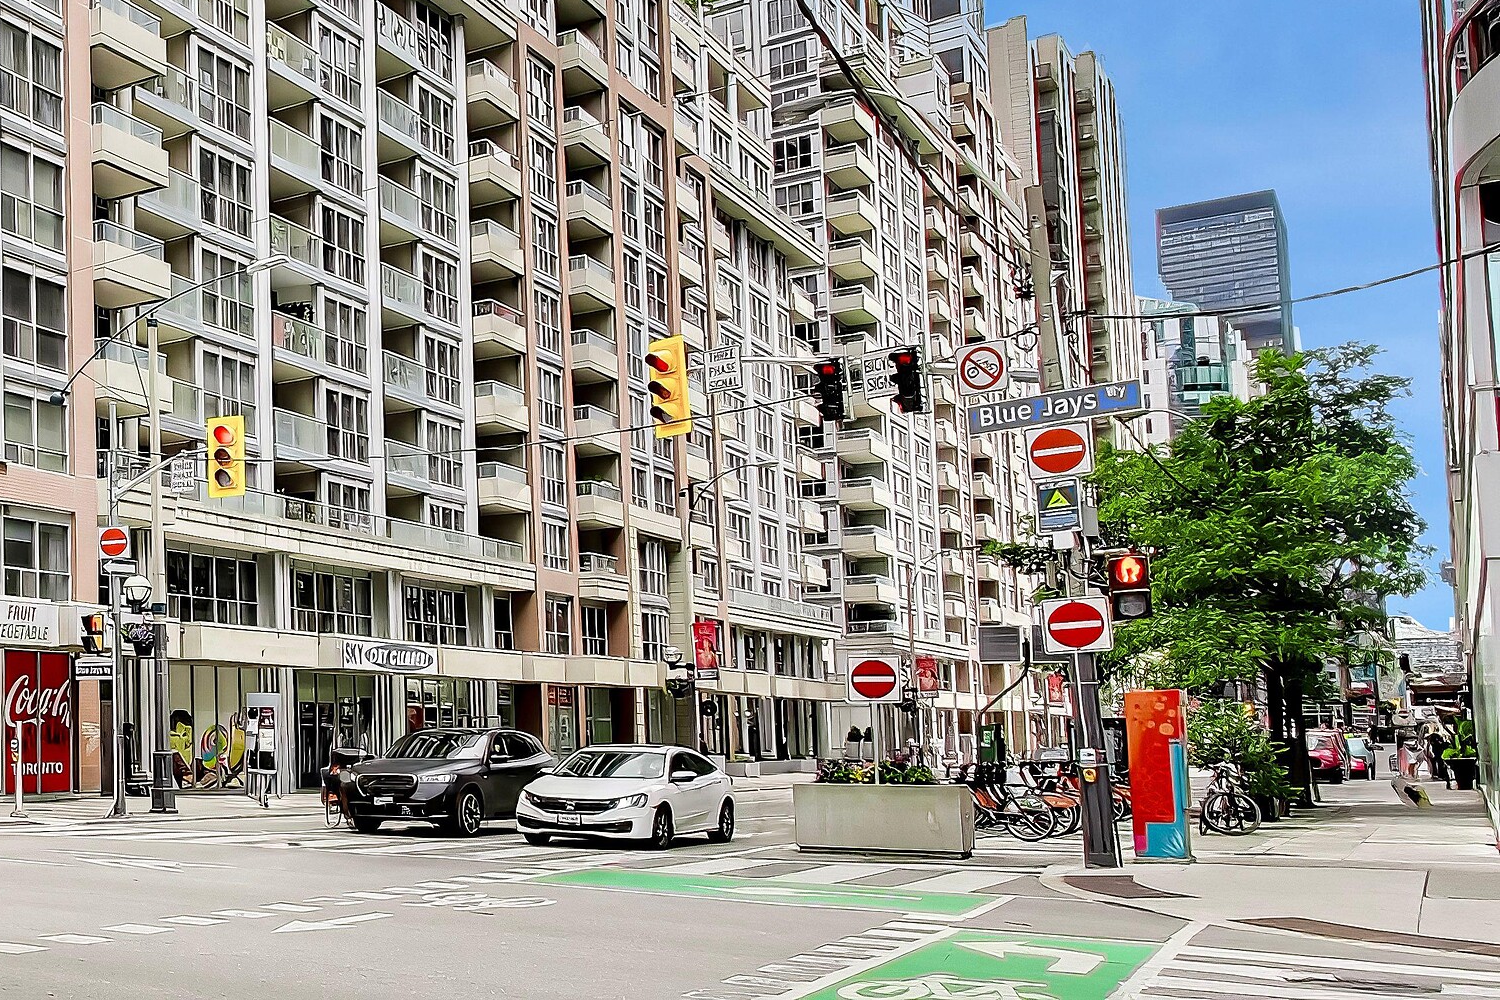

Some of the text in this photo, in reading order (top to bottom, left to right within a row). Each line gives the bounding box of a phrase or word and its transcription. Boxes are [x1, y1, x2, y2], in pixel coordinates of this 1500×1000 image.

[980, 405, 1032, 427] Blue
[1043, 392, 1097, 418] Jays
[7, 605, 37, 621] FRUIT
[345, 642, 364, 664] SKY
